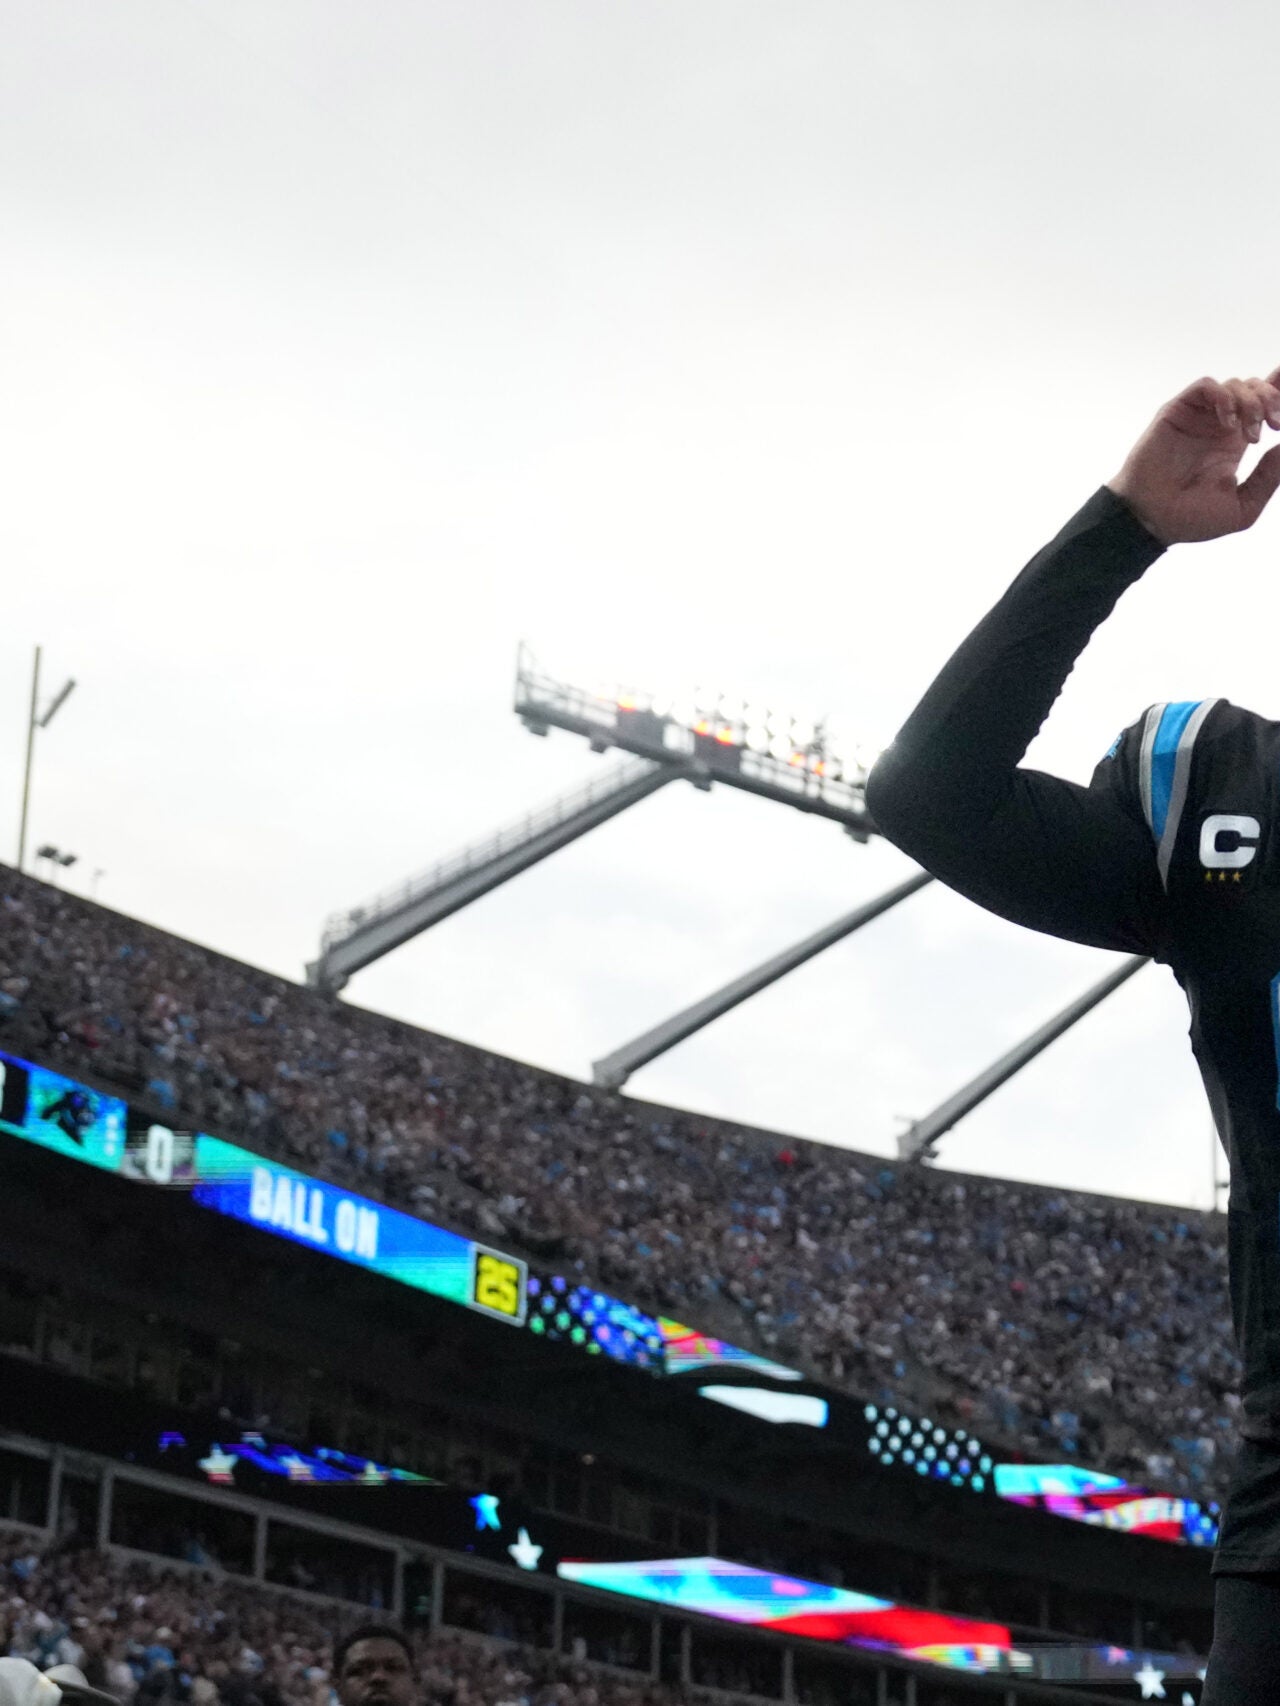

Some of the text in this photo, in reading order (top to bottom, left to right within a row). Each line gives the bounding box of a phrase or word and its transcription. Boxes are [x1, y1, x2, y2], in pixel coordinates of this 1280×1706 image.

[1199, 814, 1261, 869] C
[146, 1123, 175, 1184] 0
[250, 1165, 328, 1244] BALL
[335, 1199, 379, 1261] ON
